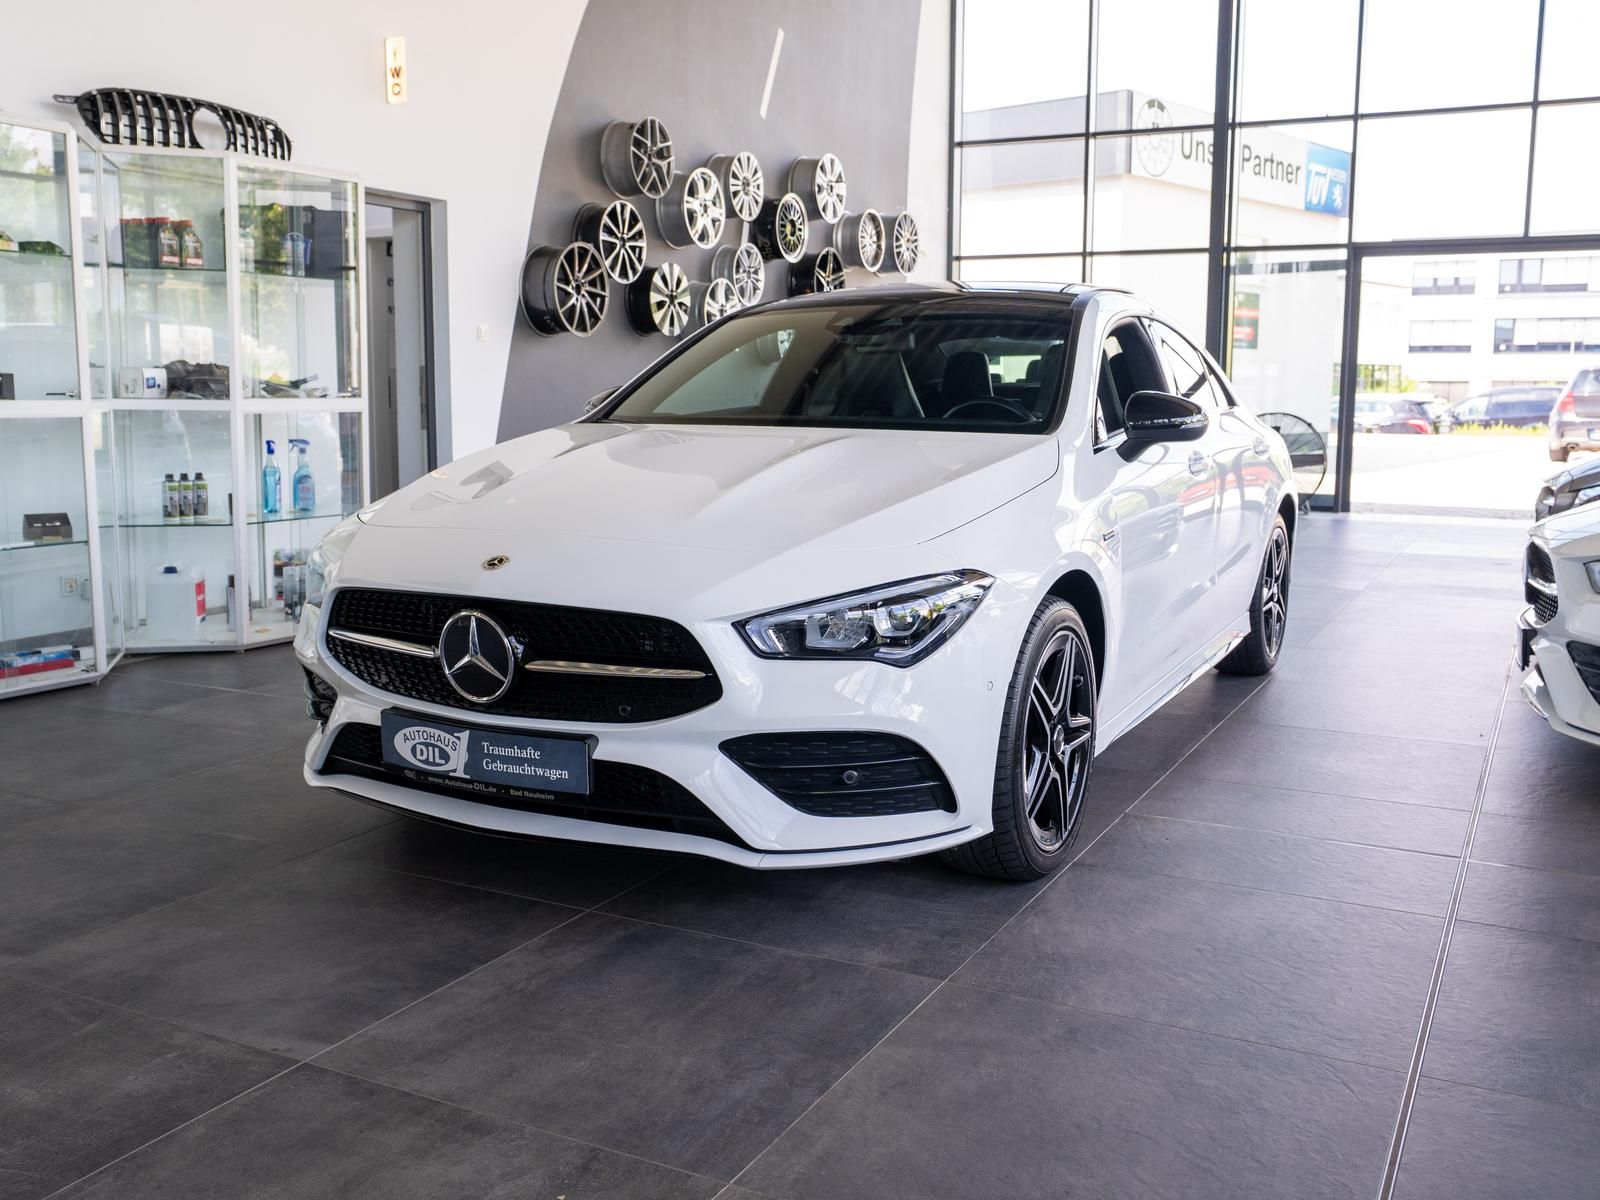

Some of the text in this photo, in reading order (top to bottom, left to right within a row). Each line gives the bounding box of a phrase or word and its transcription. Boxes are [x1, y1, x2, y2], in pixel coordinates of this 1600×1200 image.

[1181, 130, 1300, 185] Uns Partner
[403, 729, 457, 752] AUTOHAUS
[481, 741, 541, 759] Traumhafte
[415, 743, 446, 765] DIL
[483, 758, 569, 780] Gebrauchtwagen
